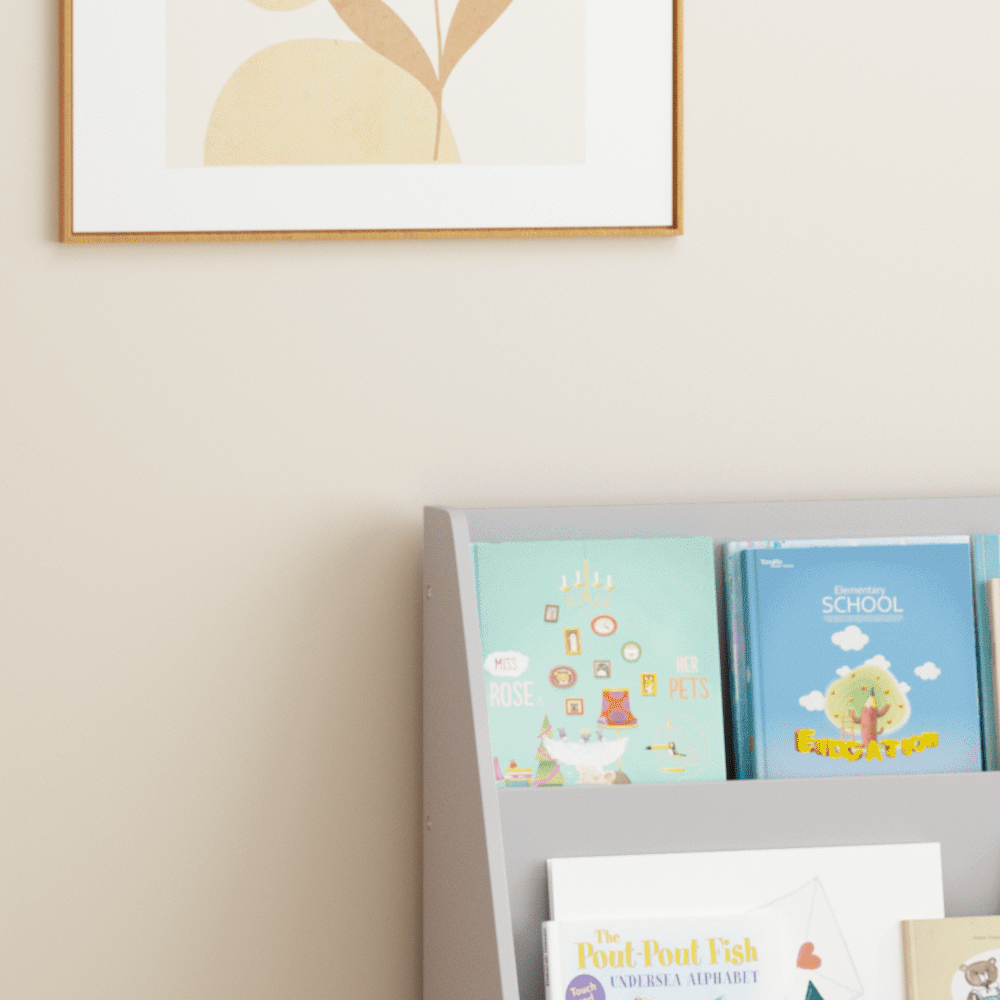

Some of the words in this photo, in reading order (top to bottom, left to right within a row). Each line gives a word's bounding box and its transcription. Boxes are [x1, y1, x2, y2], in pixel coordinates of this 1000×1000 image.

[834, 585, 886, 596] Elementary
[822, 596, 904, 613] SCHOOL
[494, 657, 518, 670] MISS
[676, 656, 699, 673] HER
[489, 681, 535, 708] ROSE
[668, 676, 710, 700] PETS
[594, 929, 621, 944] The
[574, 938, 703, 970] Pout-Pout
[706, 936, 760, 967] Fish
[610, 973, 682, 988] UNDERSEA
[689, 970, 760, 986] ALPHABET
[569, 981, 598, 998] Touch
